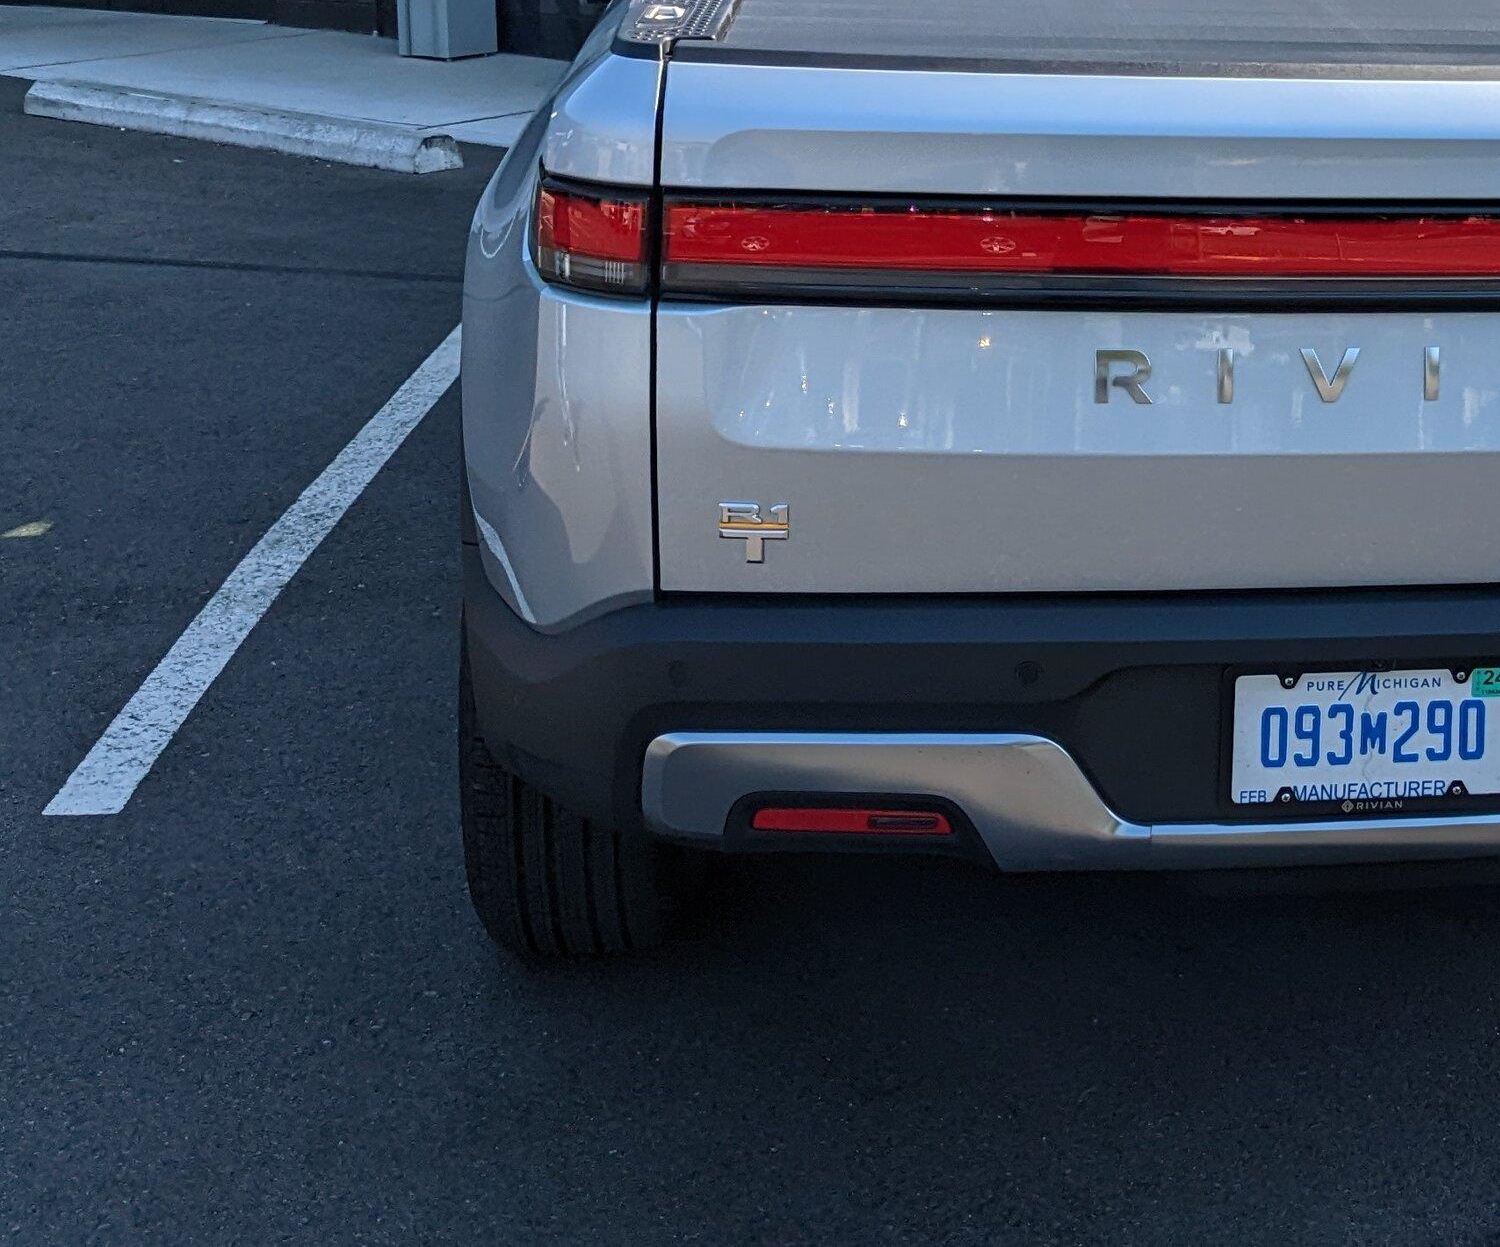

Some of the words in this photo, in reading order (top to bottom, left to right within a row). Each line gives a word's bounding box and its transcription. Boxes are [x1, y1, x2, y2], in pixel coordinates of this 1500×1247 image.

[1307, 681, 1344, 692] PURE
[1338, 671, 1442, 701] MICHIGAN
[1260, 699, 1486, 768] 093M290
[1240, 790, 1267, 804] FEB
[1292, 780, 1447, 801] MANUFACTURER
[1356, 800, 1403, 811] RIVIAN
